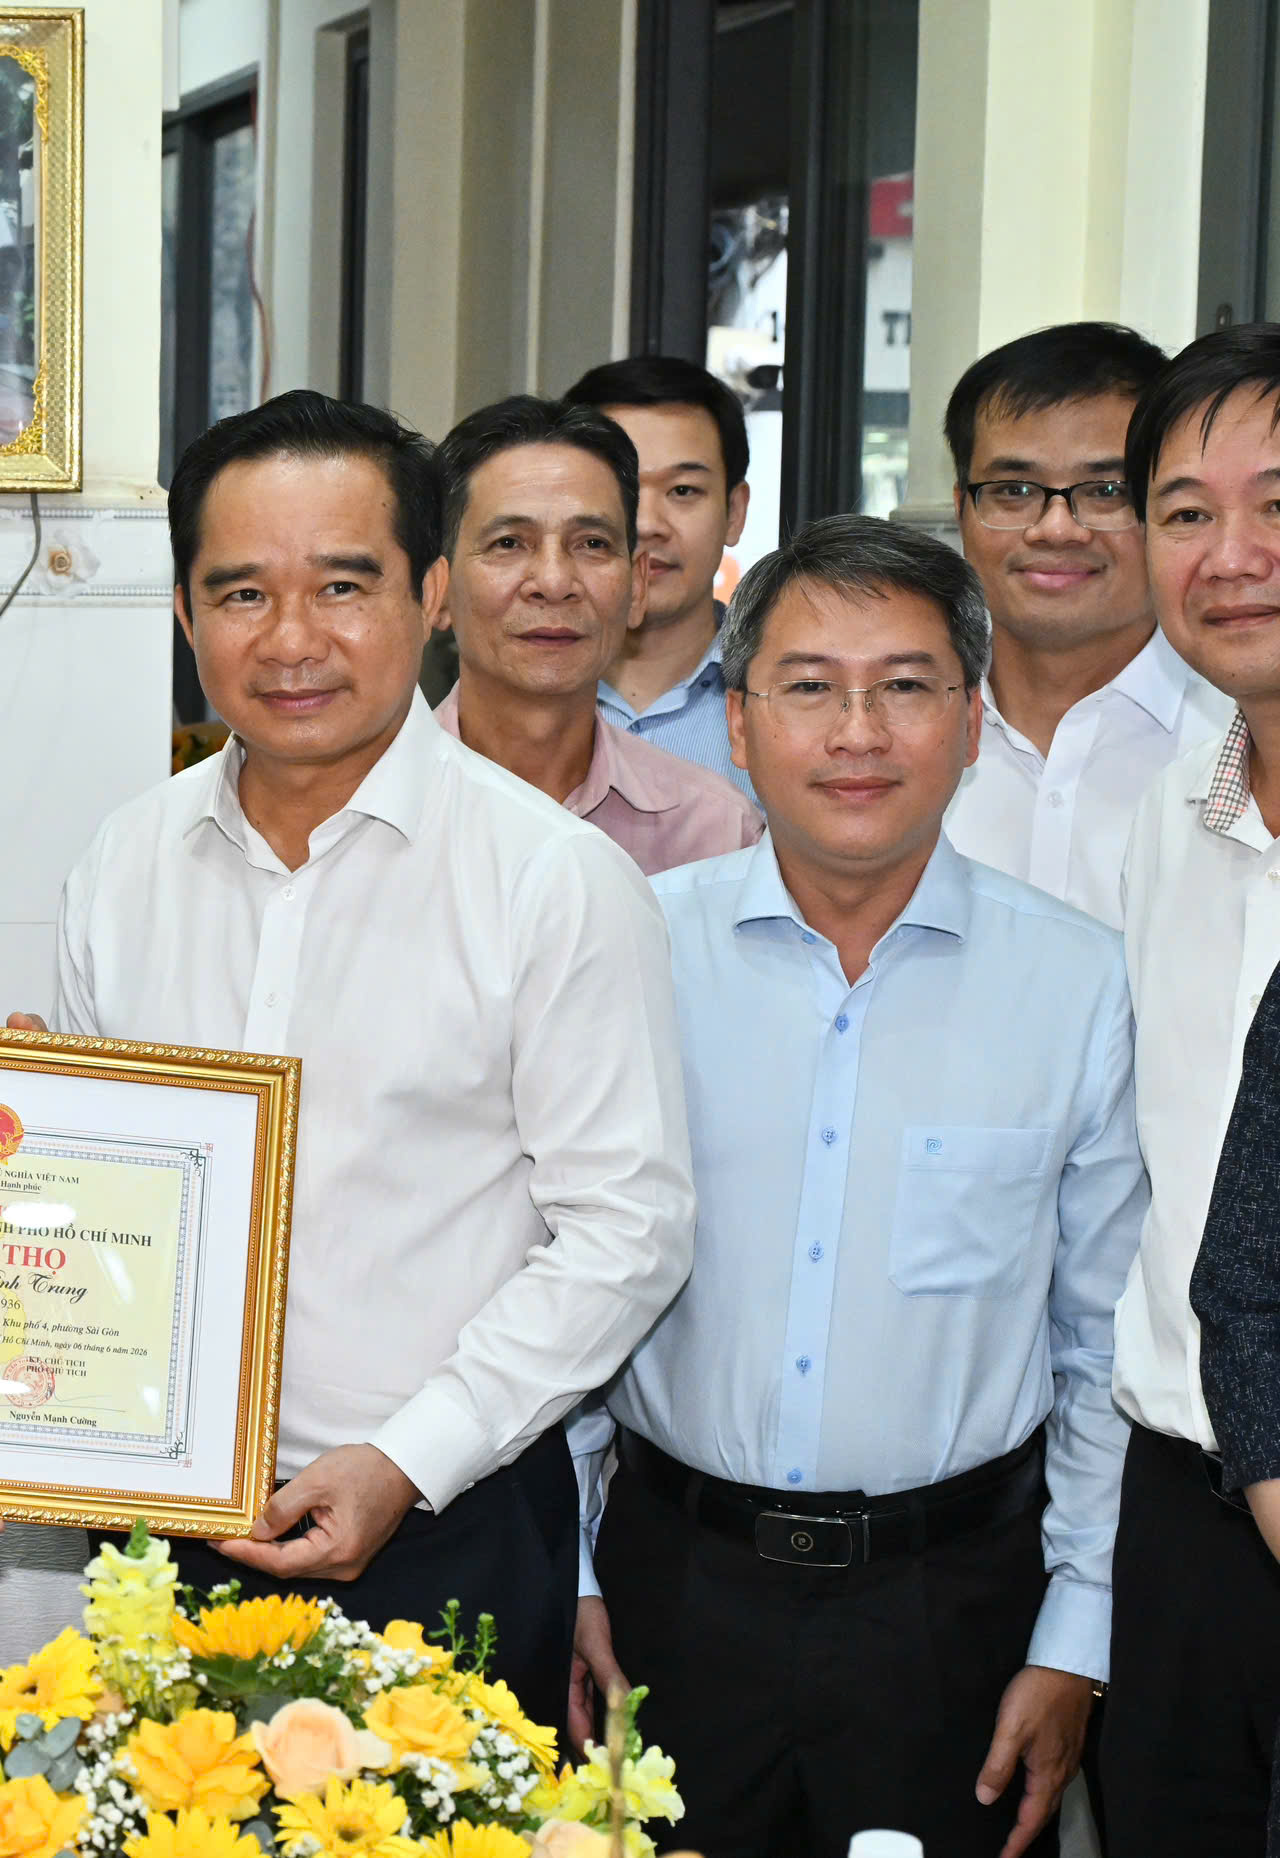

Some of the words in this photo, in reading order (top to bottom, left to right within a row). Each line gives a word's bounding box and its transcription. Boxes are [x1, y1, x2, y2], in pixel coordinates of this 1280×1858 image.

[0, 1180, 21, 1190] Hạnh
[23, 1182, 42, 1191] phúc
[36, 1171, 56, 1182] VIỆT
[59, 1174, 80, 1184] NAM
[53, 1222, 76, 1240] HỒ
[80, 1227, 107, 1243] CHÍ
[111, 1232, 152, 1247] MINH
[2, 1244, 66, 1275] THỌ
[27, 1272, 88, 1305] Trung
[2, 1318, 21, 1328] Khu
[23, 1318, 42, 1330] phố
[51, 1323, 84, 1335] phường
[85, 1326, 100, 1335] Sài
[101, 1327, 120, 1337] Gòn
[2, 1335, 14, 1345] Hồ
[15, 1336, 30, 1347] Chí
[54, 1341, 71, 1351] ngày
[73, 1341, 82, 1350] 06
[84, 1342, 105, 1353] tháng
[106, 1345, 111, 1353] 6
[112, 1346, 128, 1354] năm
[9, 1410, 41, 1424] Nguyễn
[43, 1413, 68, 1425] Mạnh
[70, 1415, 97, 1427] Cường
